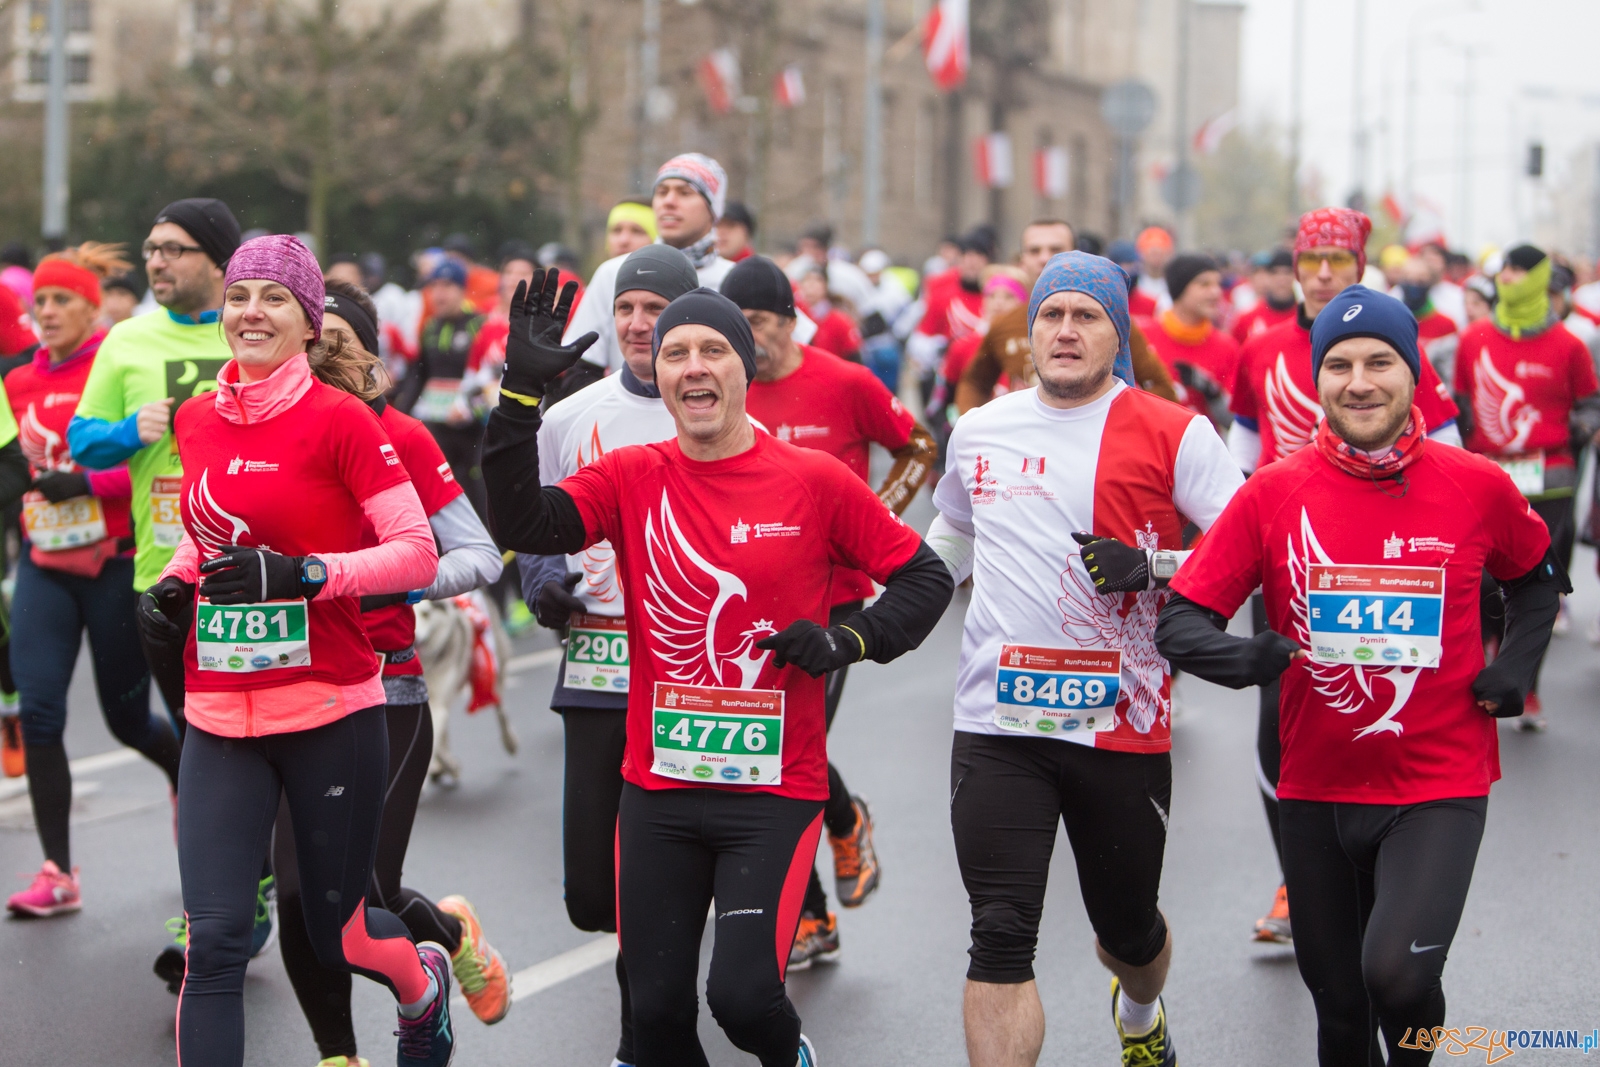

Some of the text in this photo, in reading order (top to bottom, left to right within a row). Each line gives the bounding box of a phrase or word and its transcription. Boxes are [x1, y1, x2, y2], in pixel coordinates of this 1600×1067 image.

[243, 460, 251, 472] 1
[753, 523, 763, 538] 1
[1407, 537, 1417, 552] 1
[1335, 574, 1342, 586] 1
[1379, 577, 1435, 589] RunPoland.org
[1311, 598, 1414, 632] E 414
[199, 609, 289, 640] C 4781
[1359, 636, 1388, 645] Dymitr
[234, 645, 254, 653] Alina
[574, 634, 629, 663] 290
[1024, 653, 1031, 664] 1
[1064, 658, 1113, 668] RunPoland.org
[595, 666, 619, 674] Tomasz
[999, 675, 1107, 707] E 8469
[680, 694, 687, 705] 1
[721, 699, 775, 710] RunPoland.org
[999, 715, 1020, 723] GRUPA
[1041, 709, 1072, 718] Tomasz
[656, 717, 767, 752] C 4776
[700, 754, 727, 763] Daniel
[659, 761, 677, 769] GRUPA
[726, 908, 764, 917] BROOKS
